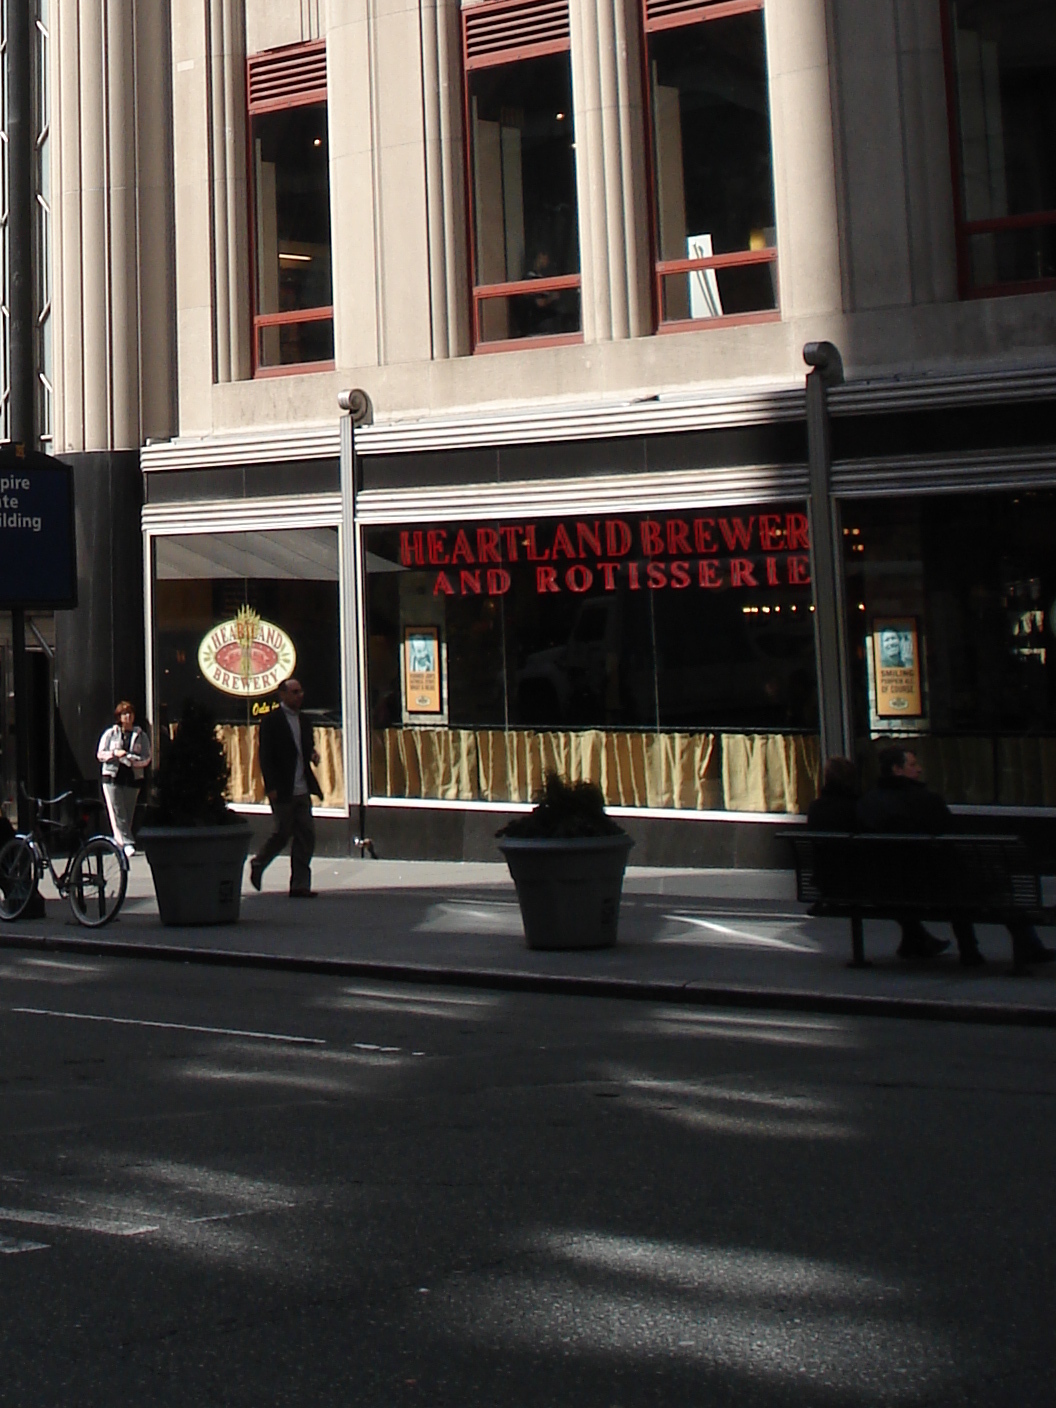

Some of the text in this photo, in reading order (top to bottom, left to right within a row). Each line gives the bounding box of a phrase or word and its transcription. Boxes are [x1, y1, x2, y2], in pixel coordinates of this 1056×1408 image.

[399, 512, 811, 567] HEARTLAND BREWER
[433, 554, 812, 597] AND ROTISSERIE
[210, 621, 284, 650] HEARTLAND
[212, 668, 279, 691] BREWERY
